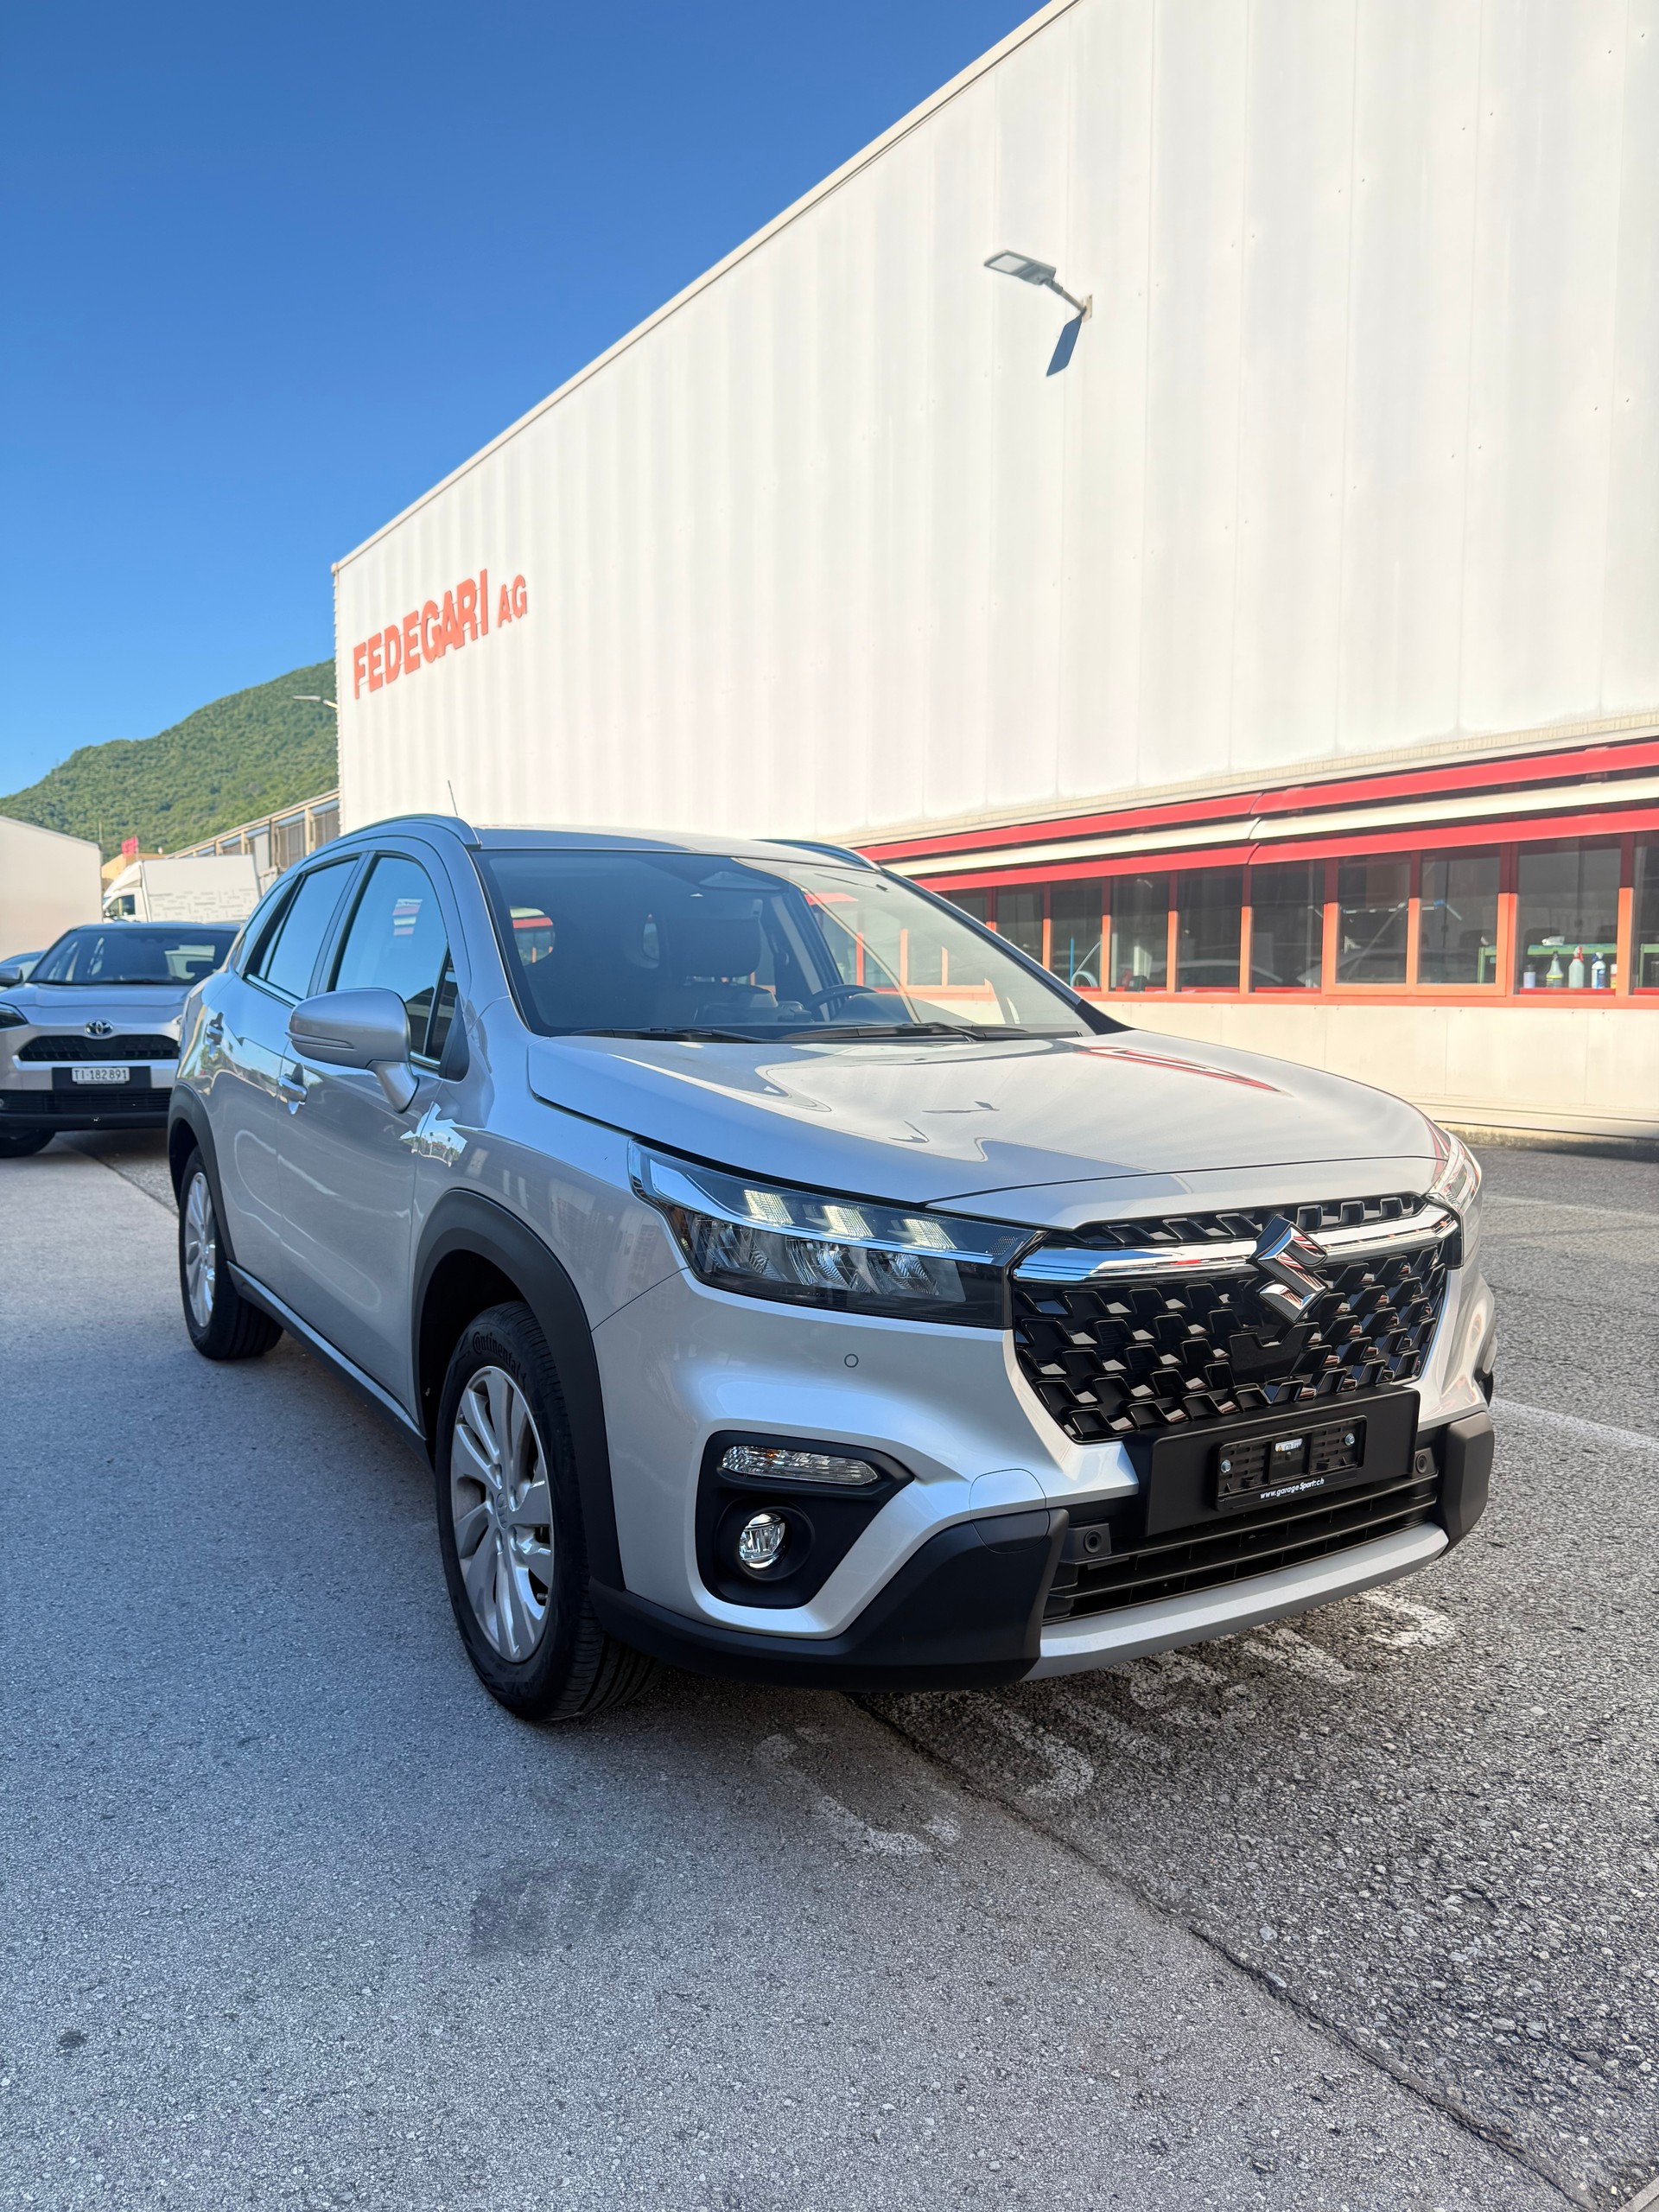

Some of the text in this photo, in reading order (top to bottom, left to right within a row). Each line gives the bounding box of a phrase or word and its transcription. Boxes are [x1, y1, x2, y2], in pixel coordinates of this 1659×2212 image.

[353, 568, 527, 700] FEDEGARI AG
[473, 1332, 521, 1380] Continental
